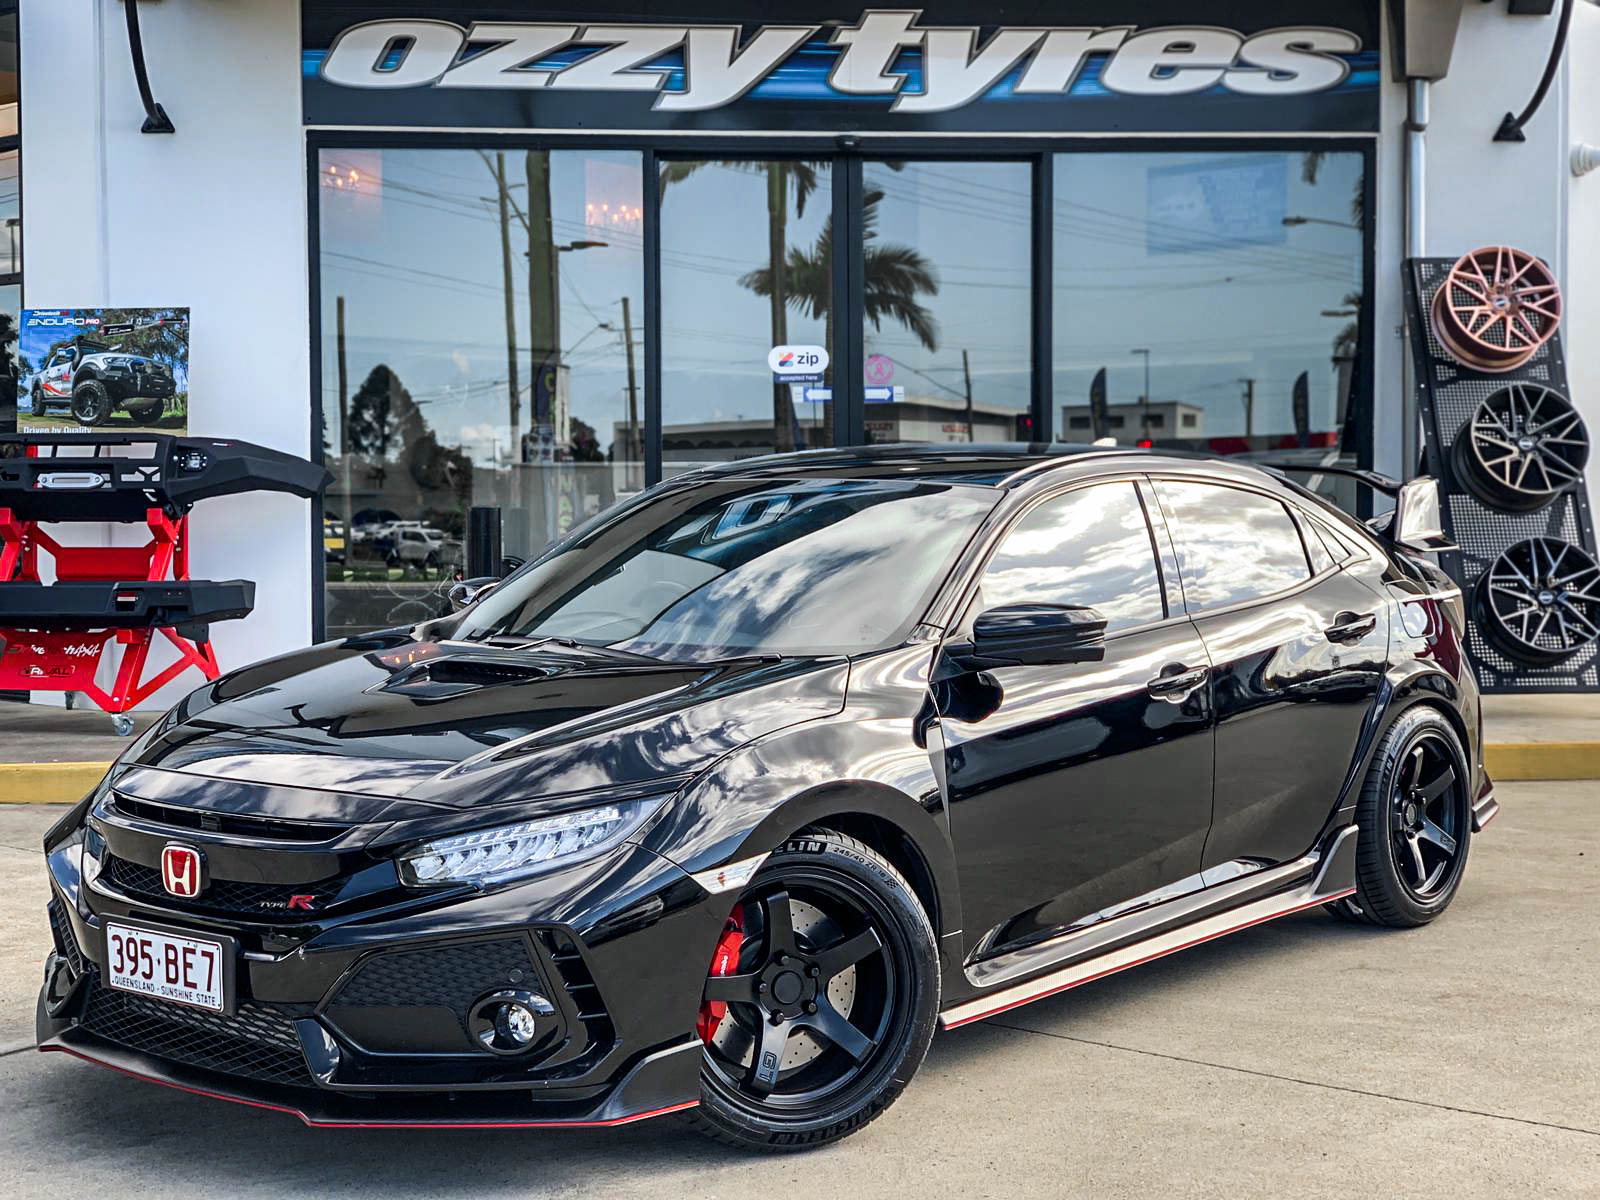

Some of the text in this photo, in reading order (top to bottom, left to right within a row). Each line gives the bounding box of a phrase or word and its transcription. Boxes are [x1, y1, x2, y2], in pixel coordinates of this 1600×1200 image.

[319, 9, 1362, 113] ozzy tyres
[797, 351, 819, 367] zip
[23, 425, 49, 434] Driven
[114, 975, 155, 992] QUEENSLAND
[161, 985, 193, 1001] SUNSHINE
[196, 993, 216, 1006] STATE
